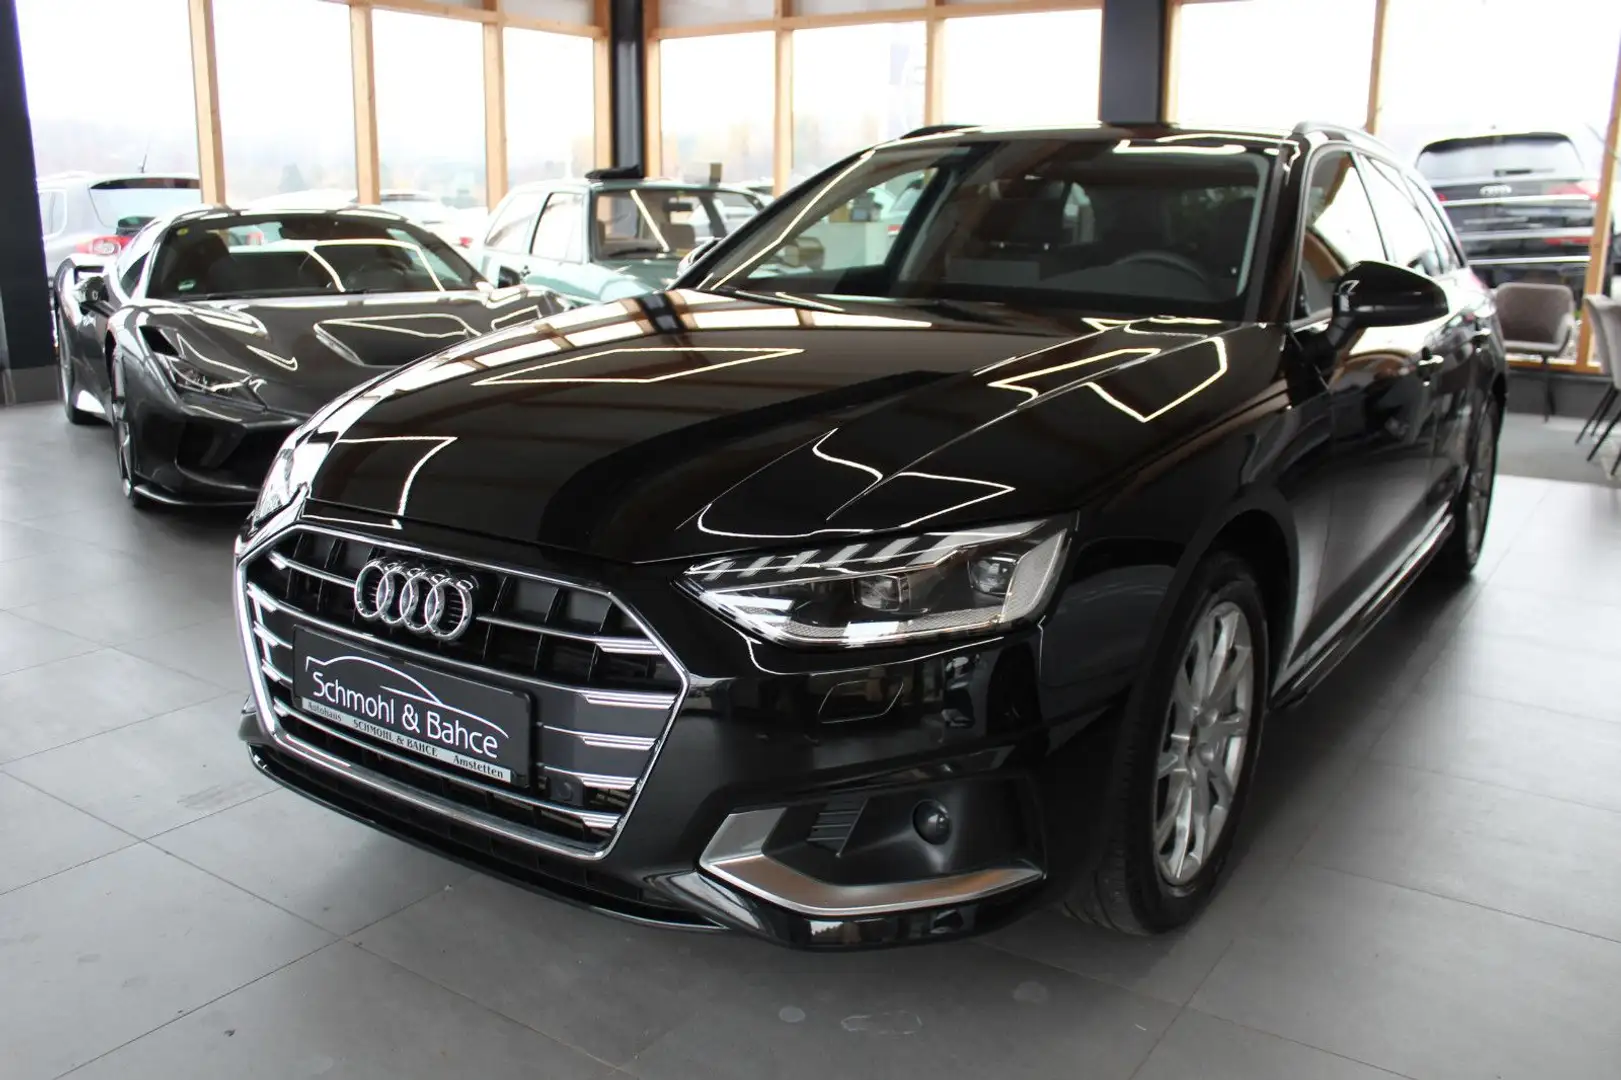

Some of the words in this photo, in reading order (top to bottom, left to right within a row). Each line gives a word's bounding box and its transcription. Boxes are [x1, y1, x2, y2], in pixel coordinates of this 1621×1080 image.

[307, 701, 342, 722] Autohaus
[353, 719, 392, 741] SCHMOHL
[397, 734, 405, 745] &
[406, 737, 438, 757] BAHCE
[453, 755, 504, 779] Amstetten
[312, 671, 395, 725] Schmohl
[402, 703, 420, 734] &
[427, 711, 498, 759] Bahce
